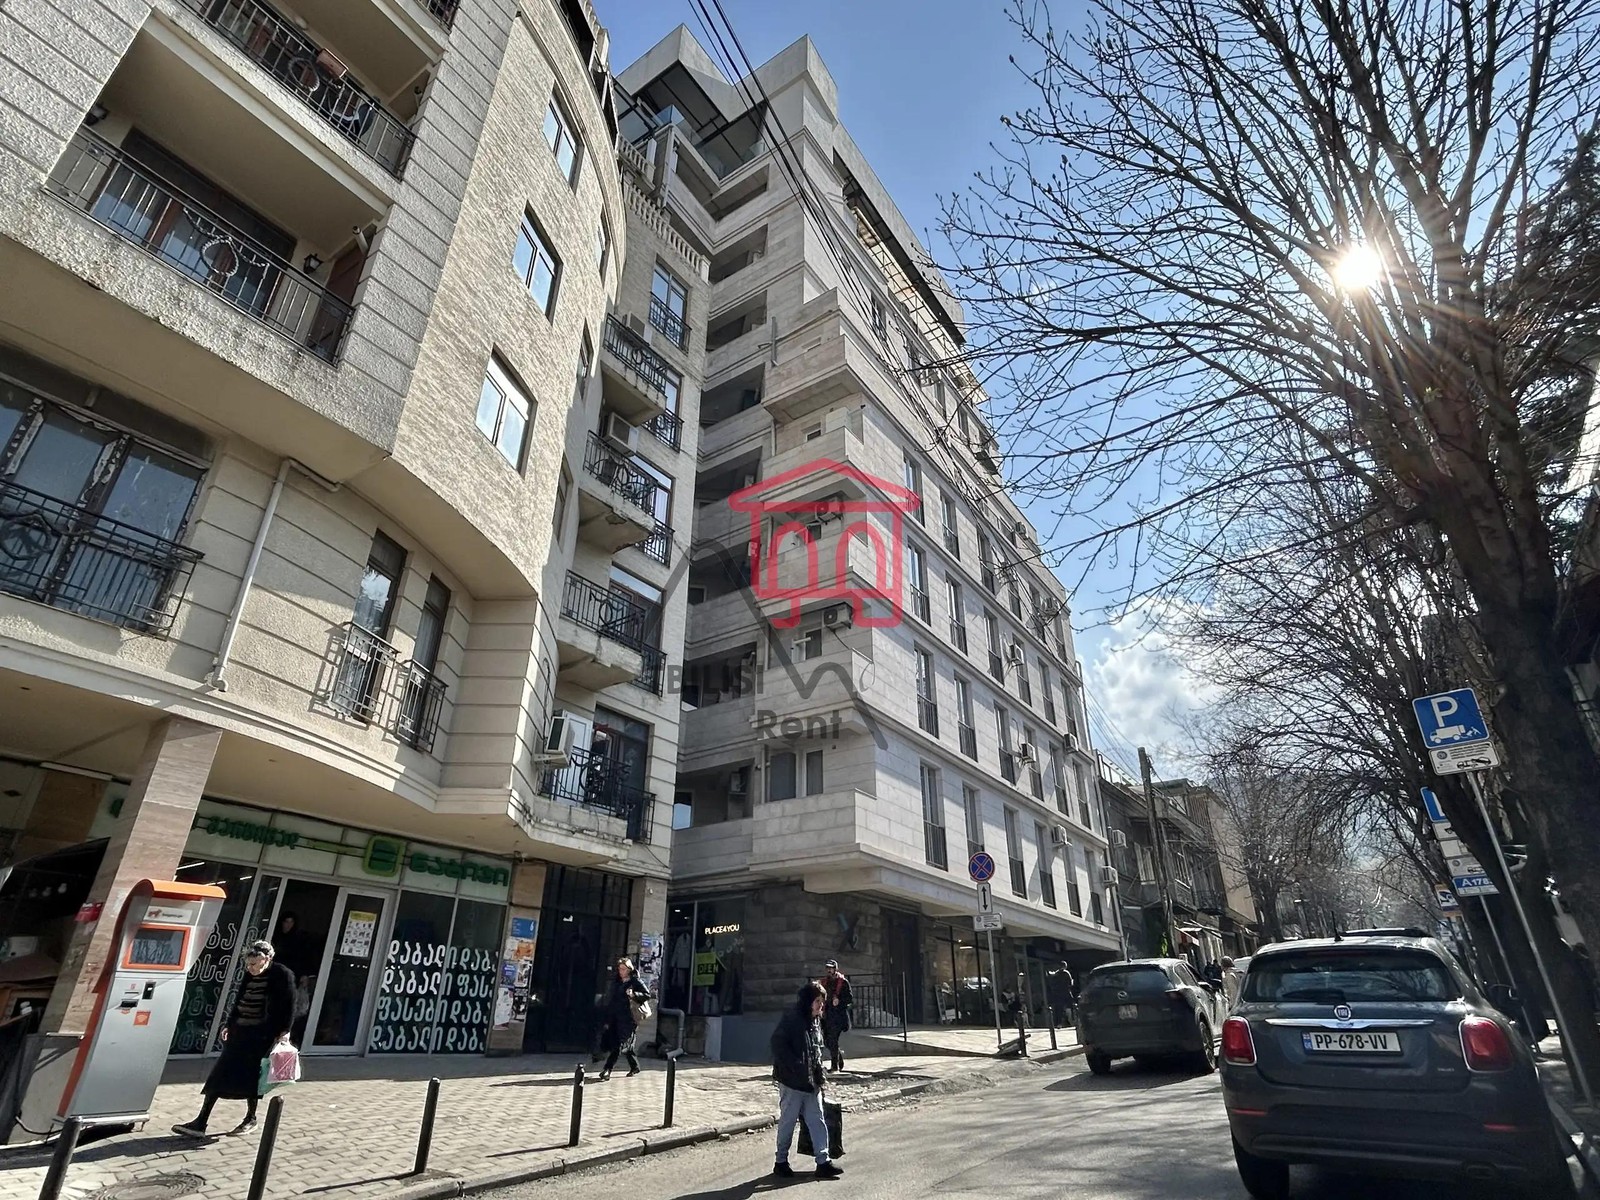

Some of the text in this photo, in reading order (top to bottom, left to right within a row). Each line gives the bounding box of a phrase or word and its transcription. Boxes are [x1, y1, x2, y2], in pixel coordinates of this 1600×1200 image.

[1431, 696, 1458, 727] P
[410, 853, 509, 886] ნაბიჯი
[704, 923, 740, 935] PLACE4YOU
[387, 940, 458, 969] დაბალი
[381, 969, 453, 996] დაბალი
[377, 996, 448, 1023] ფასები
[370, 1025, 443, 1051] დაბალი
[1314, 1034, 1388, 1050] PP-678-VV
